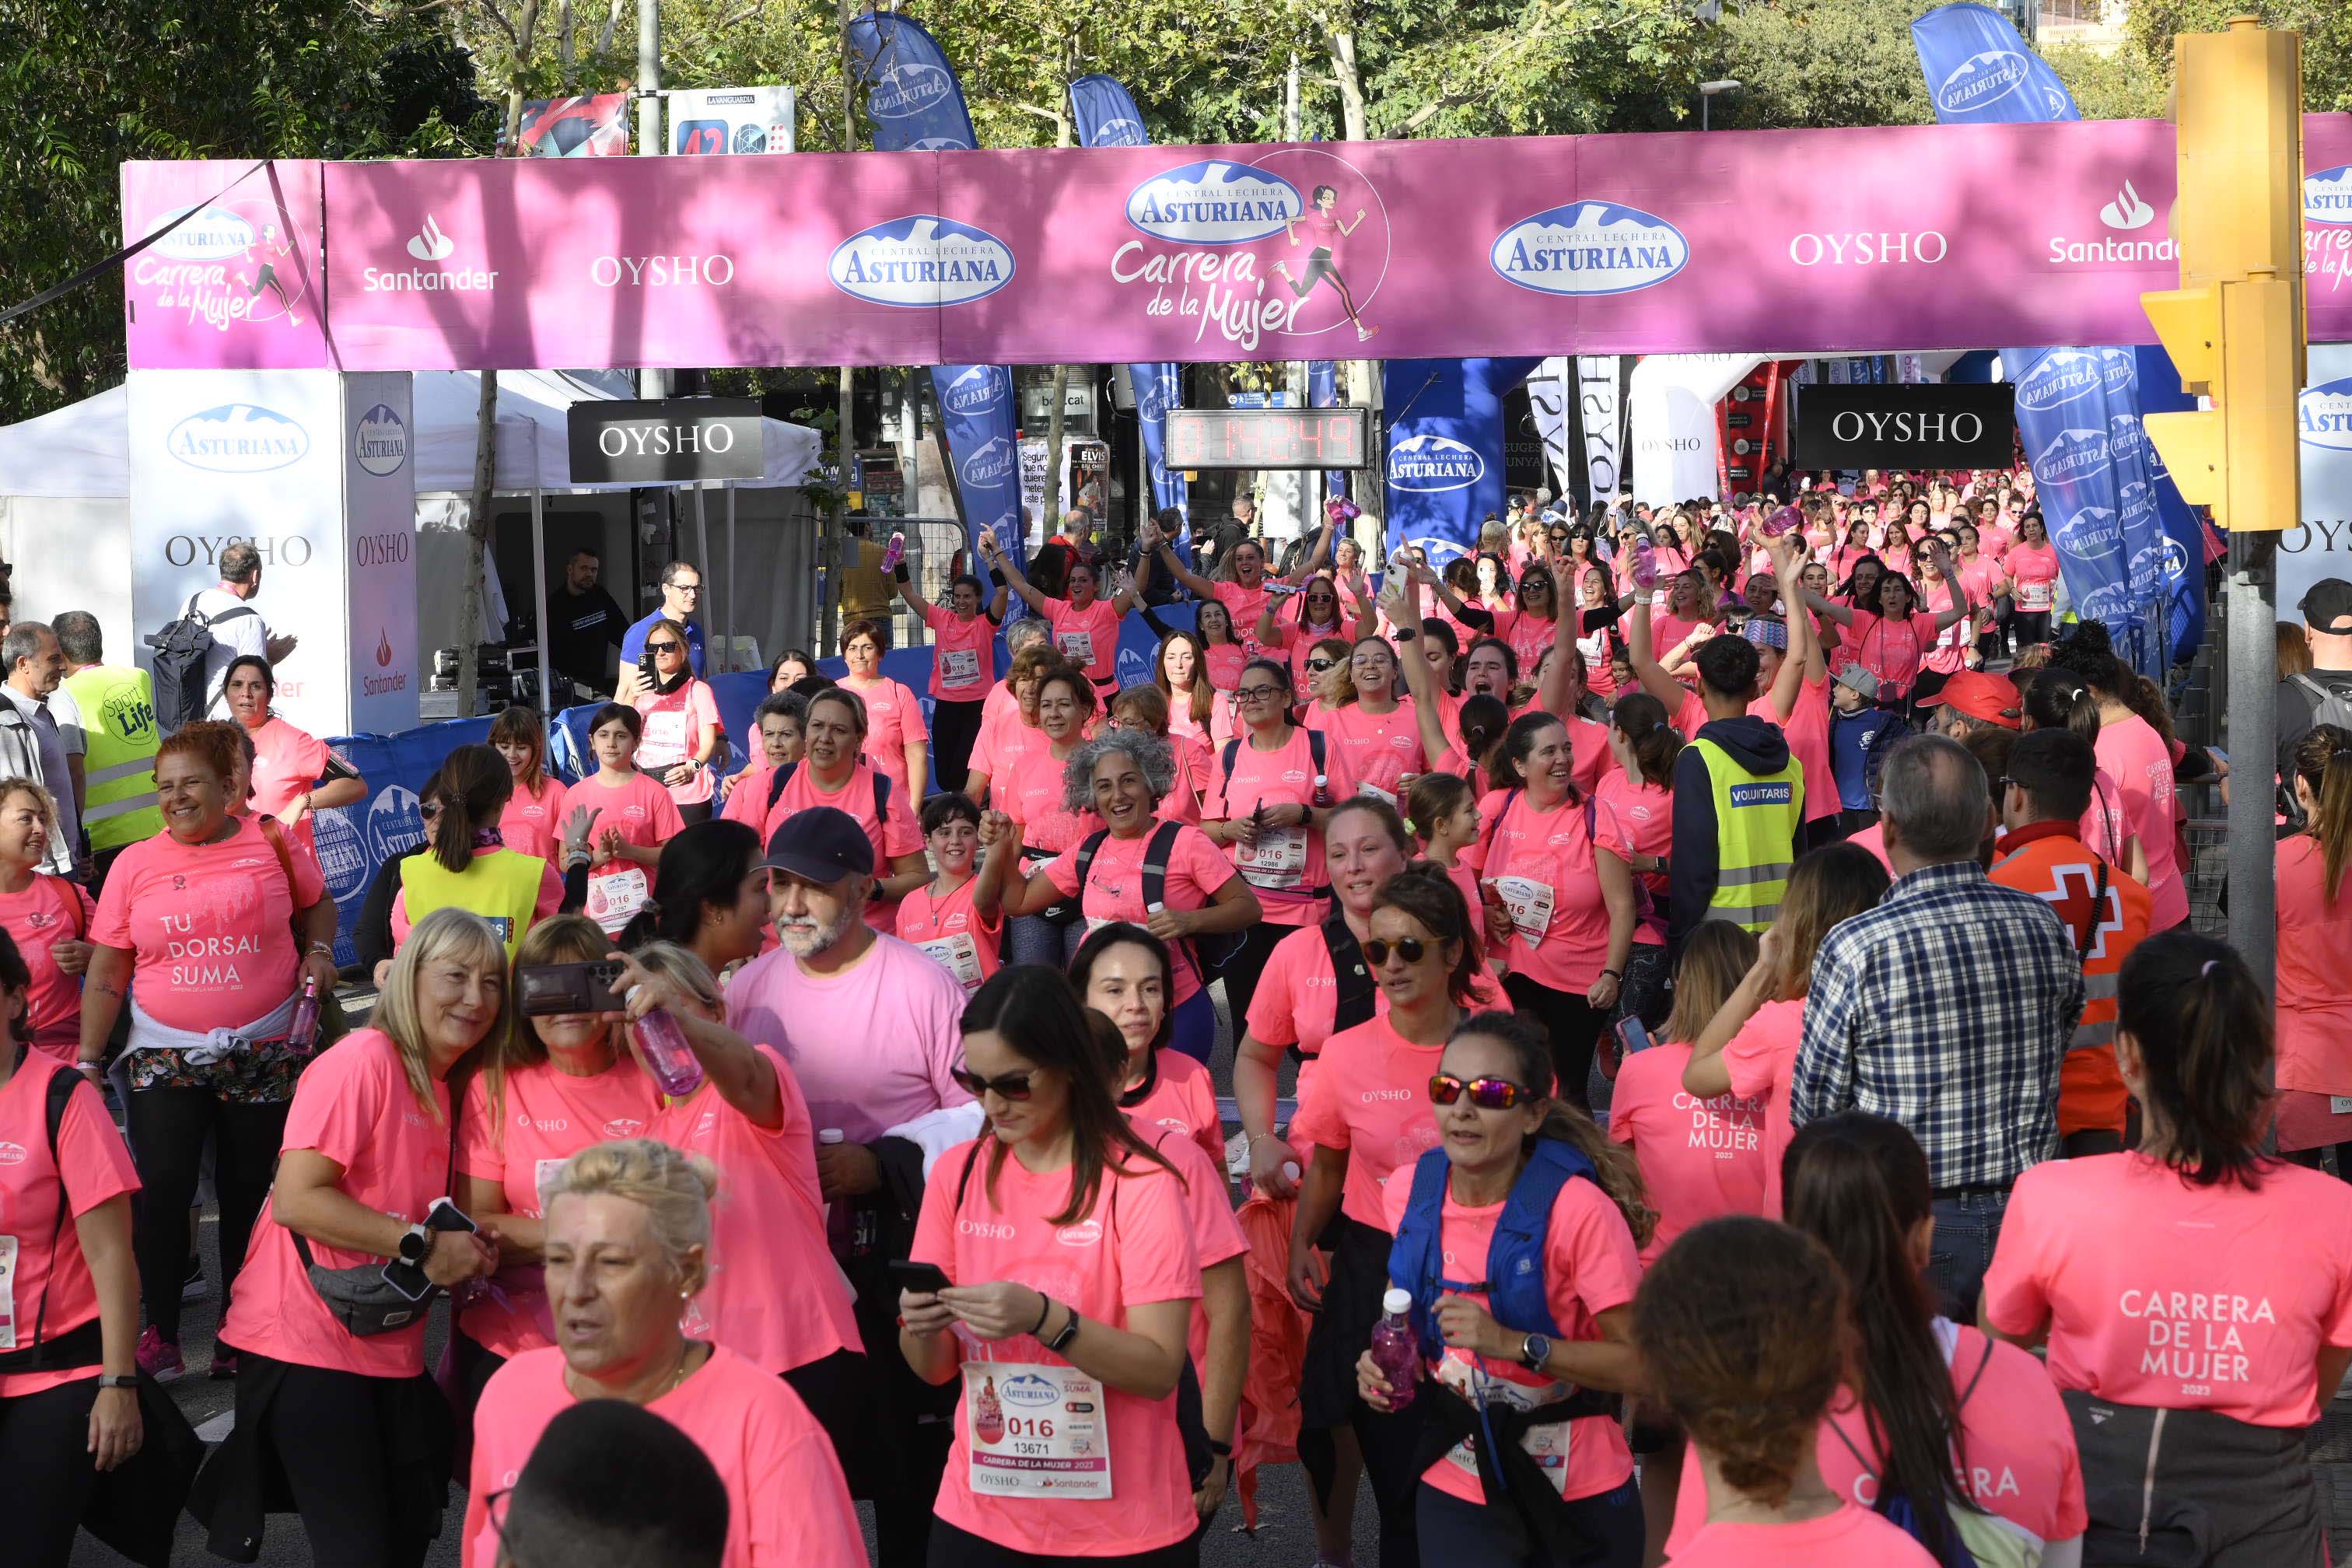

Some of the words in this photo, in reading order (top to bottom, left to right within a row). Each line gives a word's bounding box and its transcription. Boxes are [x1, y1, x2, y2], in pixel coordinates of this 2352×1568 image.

[716, 95, 754, 103] VANGUARDIA
[1227, 187, 1285, 197] LECHERA
[1139, 193, 1289, 225] ASTURIANA
[1536, 234, 1598, 244] CENTRAL
[1603, 232, 1668, 243] LECHERA
[1789, 230, 1948, 267] OYSHO
[870, 247, 930, 256] CENTRAL
[933, 246, 996, 255] LECHERA
[1505, 236, 1674, 272] ASTURIANA
[134, 256, 226, 285] Carrera
[590, 254, 735, 287] OYSHO
[842, 253, 1002, 285] ASTURIANA
[1110, 240, 1257, 285] Carrera
[362, 267, 499, 292] Santander
[157, 287, 174, 307] de
[177, 289, 191, 306] la
[187, 283, 261, 332] Mujer
[1146, 286, 1173, 317] de
[1179, 284, 1199, 317] la
[1194, 278, 1311, 352] Mujer
[1832, 411, 1983, 443] OYSHO
[177, 427, 300, 457] ASTURIANA
[359, 431, 404, 459] ASTURIANA
[598, 422, 735, 458] OYSHO
[1642, 437, 1701, 451] OYSHO
[1081, 450, 1106, 461] ELVIS
[1024, 464, 1036, 473] que
[1388, 457, 1477, 481] ASTURIANA
[1025, 495, 1038, 503] este
[356, 530, 408, 568] OYSHO
[951, 663, 965, 672] 016
[363, 670, 407, 698] Santander
[103, 685, 142, 718] Sport
[117, 702, 154, 737] Life
[1259, 849, 1283, 860] 016
[609, 894, 629, 907] 016
[1503, 884, 1531, 898] ASTURIANA
[159, 913, 191, 934] TU
[168, 934, 261, 958] DORSAL
[170, 964, 241, 985] SUMA
[1362, 1090, 1412, 1104] OYSHO
[517, 1114, 568, 1132] OSHO
[1692, 1110, 1720, 1129] DE
[1729, 1111, 1755, 1131] LA
[1687, 1129, 1759, 1151] MUJER
[959, 1219, 1016, 1240] OYSHO
[2119, 1288, 2276, 1325] CARRERA
[2147, 1319, 2191, 1349] DE
[2204, 1322, 2245, 1353] LA
[2140, 1347, 2250, 1382] MUJER
[1004, 1385, 1055, 1401] ASTURIANA
[1063, 1384, 1091, 1394] SUMA
[2181, 1382, 2212, 1397] 2023
[1008, 1417, 1055, 1438] 016
[1013, 1441, 1050, 1456] 13671
[982, 1454, 1017, 1466] CARRERA
[1017, 1458, 1030, 1467] DE
[1031, 1459, 1041, 1468] LA
[1043, 1459, 1072, 1469] MUJER
[1074, 1460, 1094, 1469] 2023
[980, 1472, 1020, 1488] OYSHO
[1053, 1479, 1099, 1489] Santander
